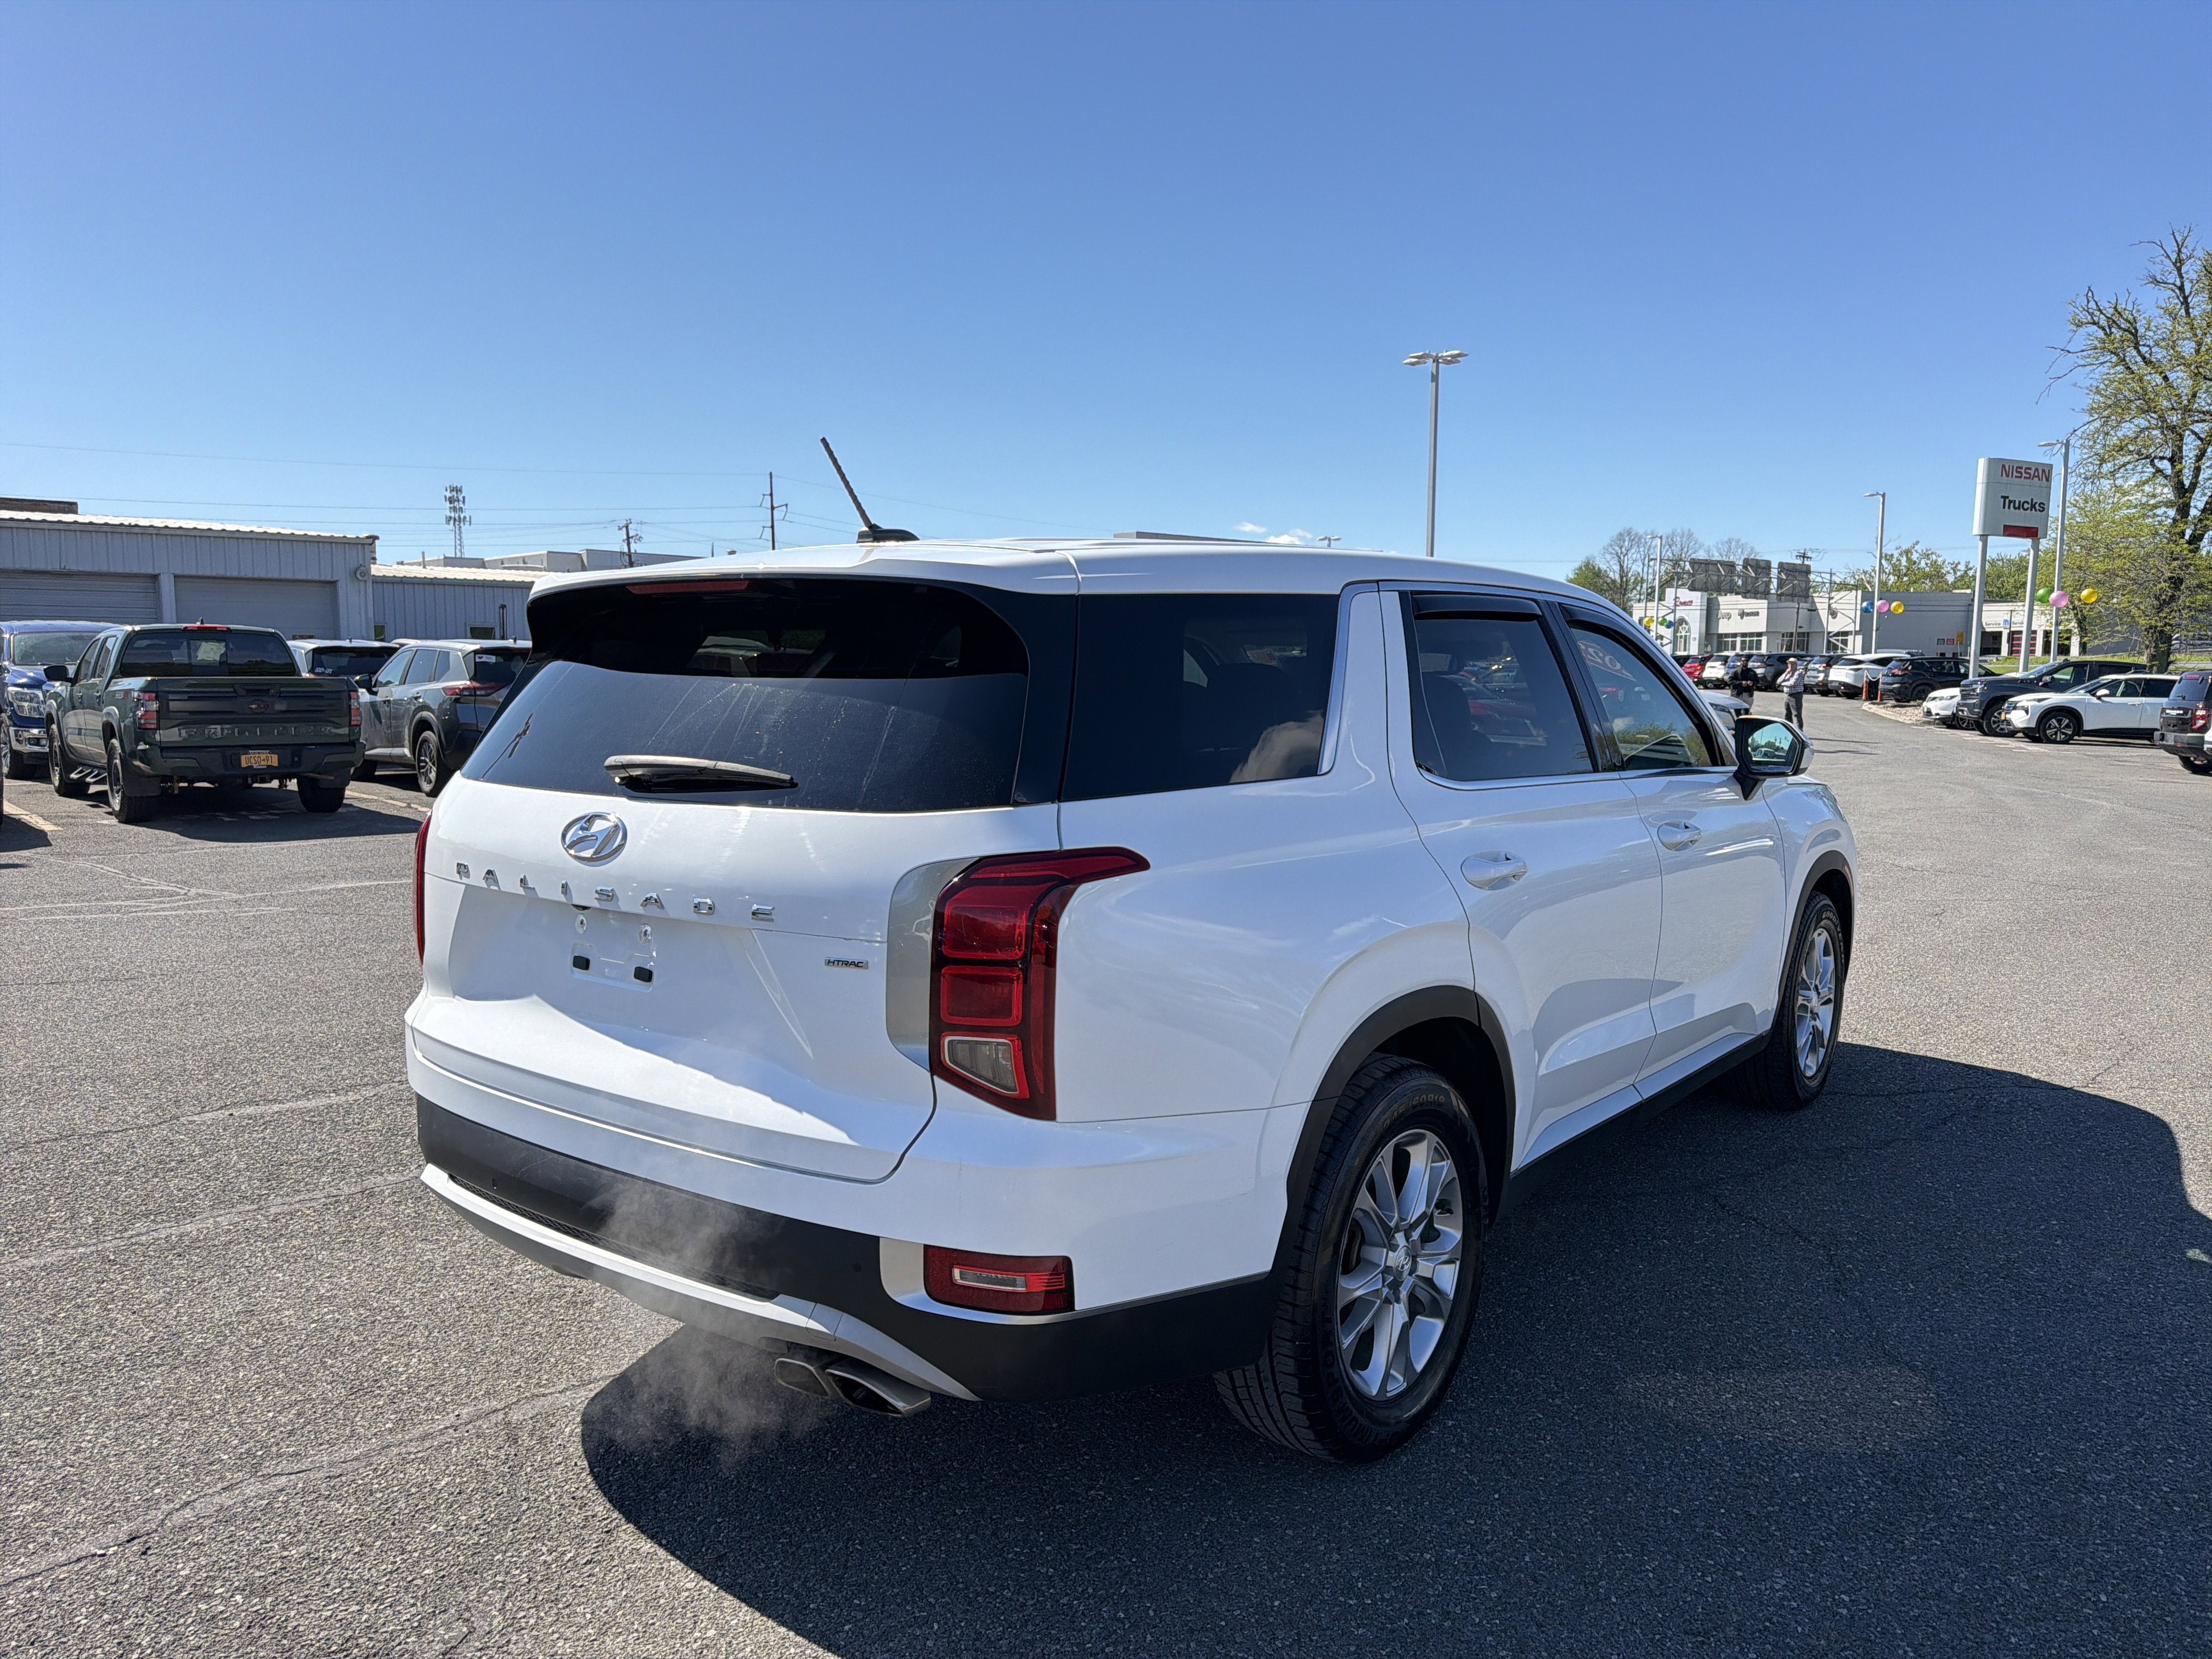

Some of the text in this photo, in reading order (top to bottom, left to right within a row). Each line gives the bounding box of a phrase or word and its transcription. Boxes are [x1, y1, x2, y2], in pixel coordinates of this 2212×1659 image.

[2000, 464, 2051, 482] NISSAN
[2000, 495, 2046, 512] Trucks
[456, 861, 774, 922] PALISADE
[827, 958, 864, 968] HTRAC
